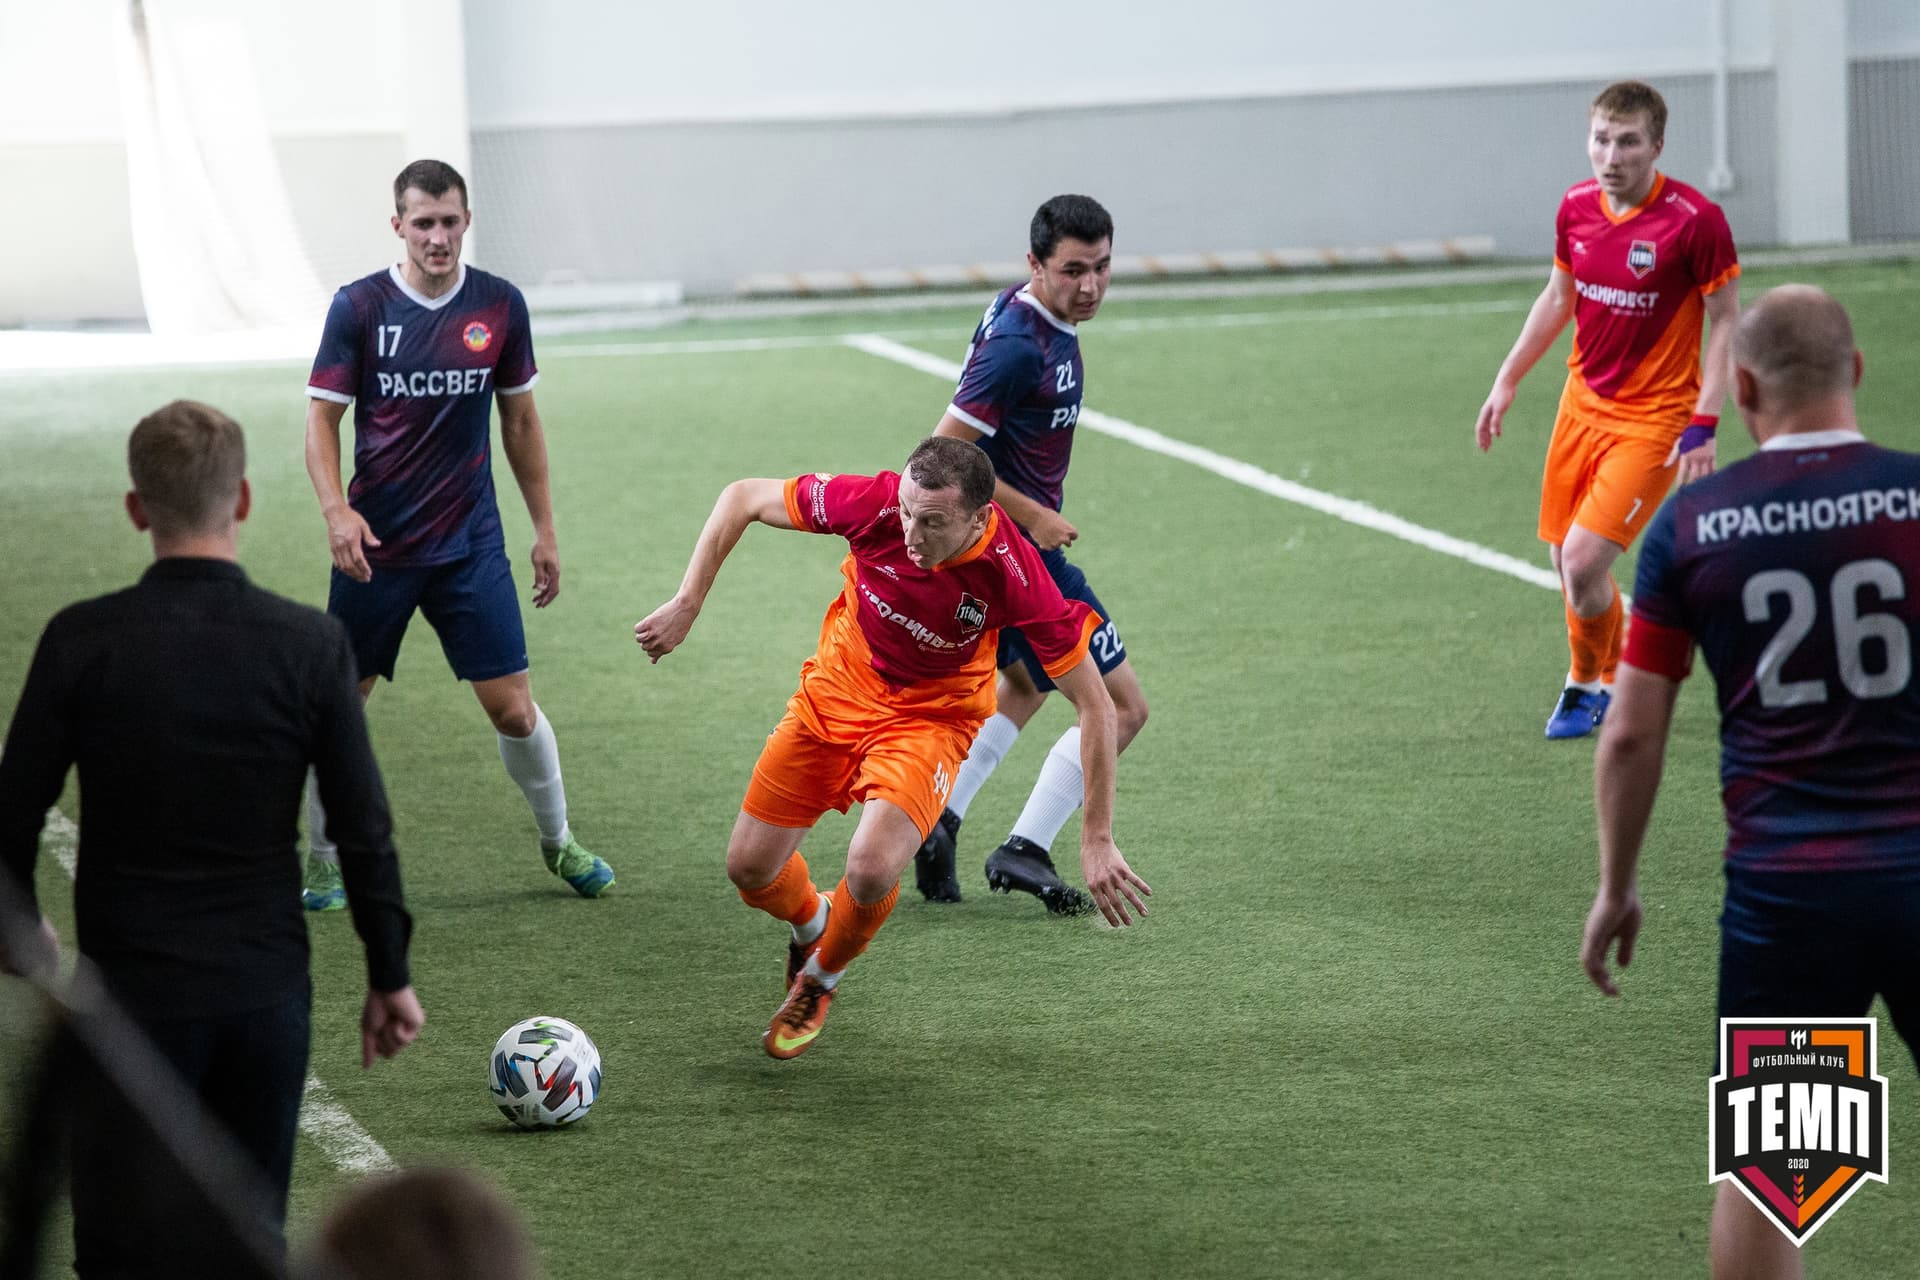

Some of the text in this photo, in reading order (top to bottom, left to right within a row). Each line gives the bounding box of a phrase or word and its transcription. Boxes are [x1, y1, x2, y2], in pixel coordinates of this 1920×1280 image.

[377, 324, 403, 357] 17
[377, 366, 492, 398] РАССВЕТ
[1055, 359, 1076, 394] 22
[1092, 620, 1124, 663] 22
[1741, 557, 1912, 709] 26
